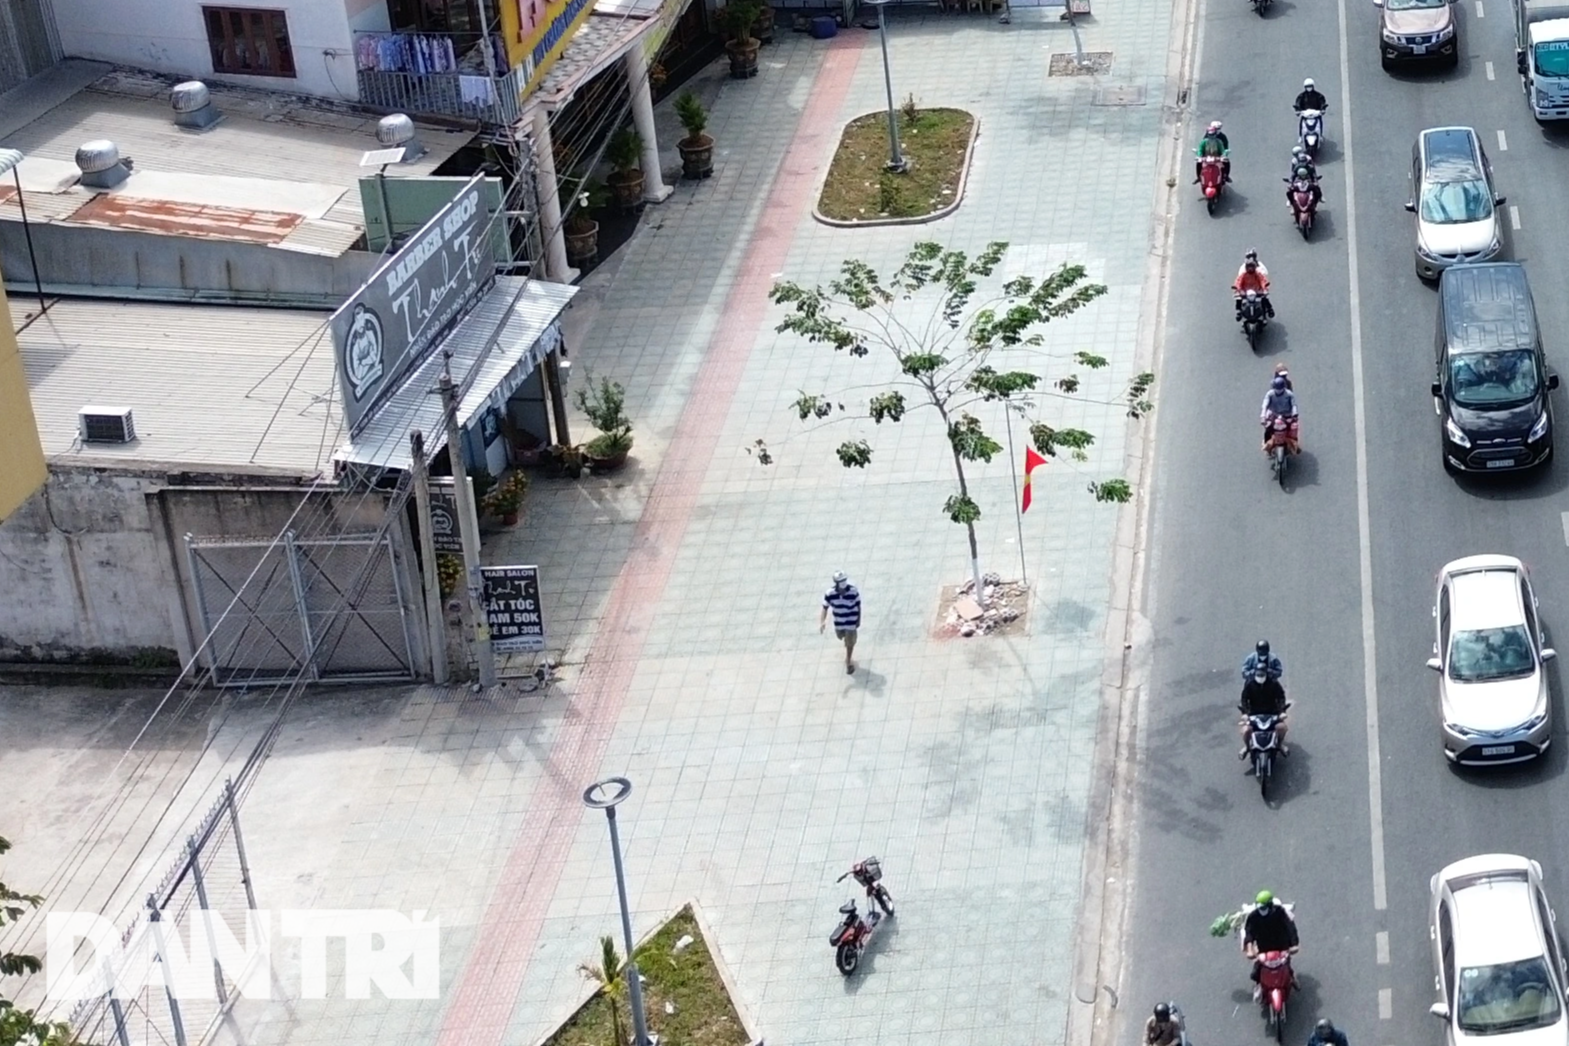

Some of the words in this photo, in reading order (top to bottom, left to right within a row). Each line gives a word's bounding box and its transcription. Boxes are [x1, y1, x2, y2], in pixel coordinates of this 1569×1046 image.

[385, 225, 444, 297] BARBER
[442, 189, 480, 241] SHOP
[484, 570, 505, 578] HAIR
[506, 569, 535, 577] SALON
[508, 597, 536, 611] TÓC
[489, 612, 511, 624] AM
[513, 611, 540, 623] 50K
[502, 625, 519, 635] EM
[520, 625, 542, 634] 30K
